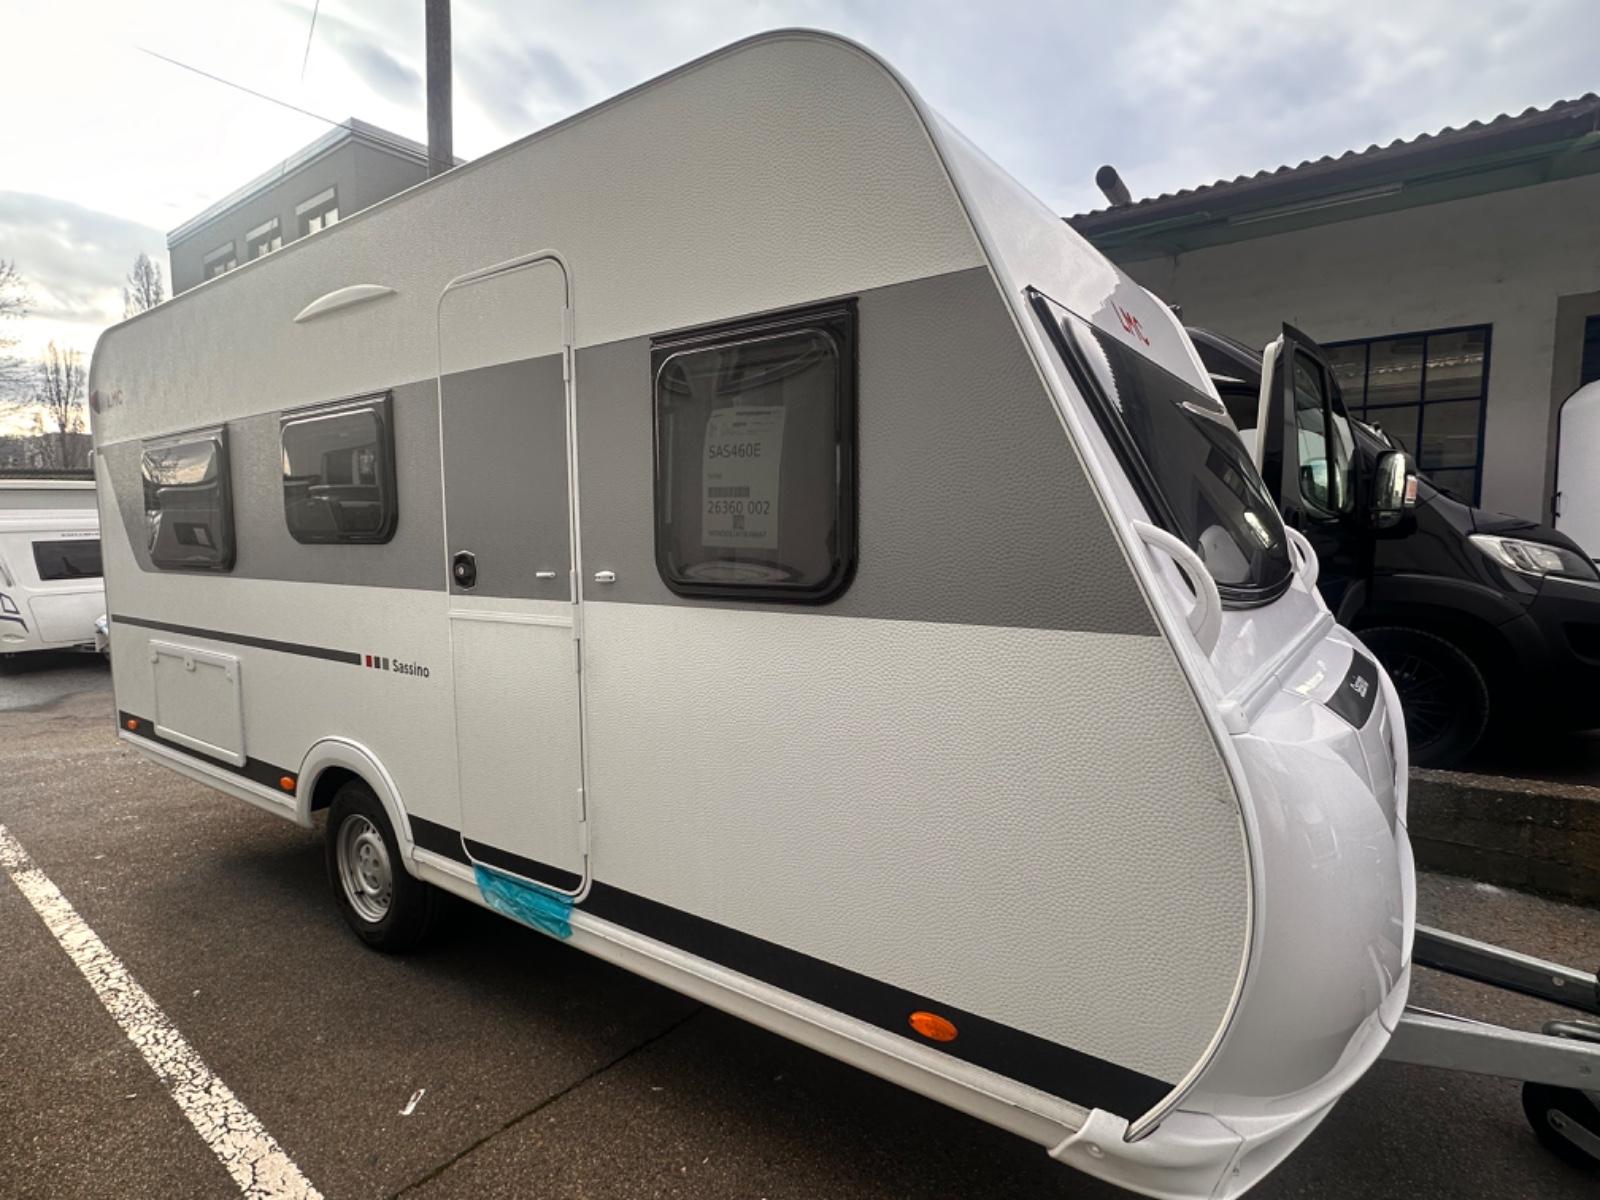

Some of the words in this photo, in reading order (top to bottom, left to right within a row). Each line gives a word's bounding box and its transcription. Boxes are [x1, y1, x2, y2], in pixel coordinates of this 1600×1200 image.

[708, 442, 761, 459] SAS460E
[707, 500, 744, 514] 26360
[747, 500, 771, 515] 002
[392, 658, 430, 678] Sassino
